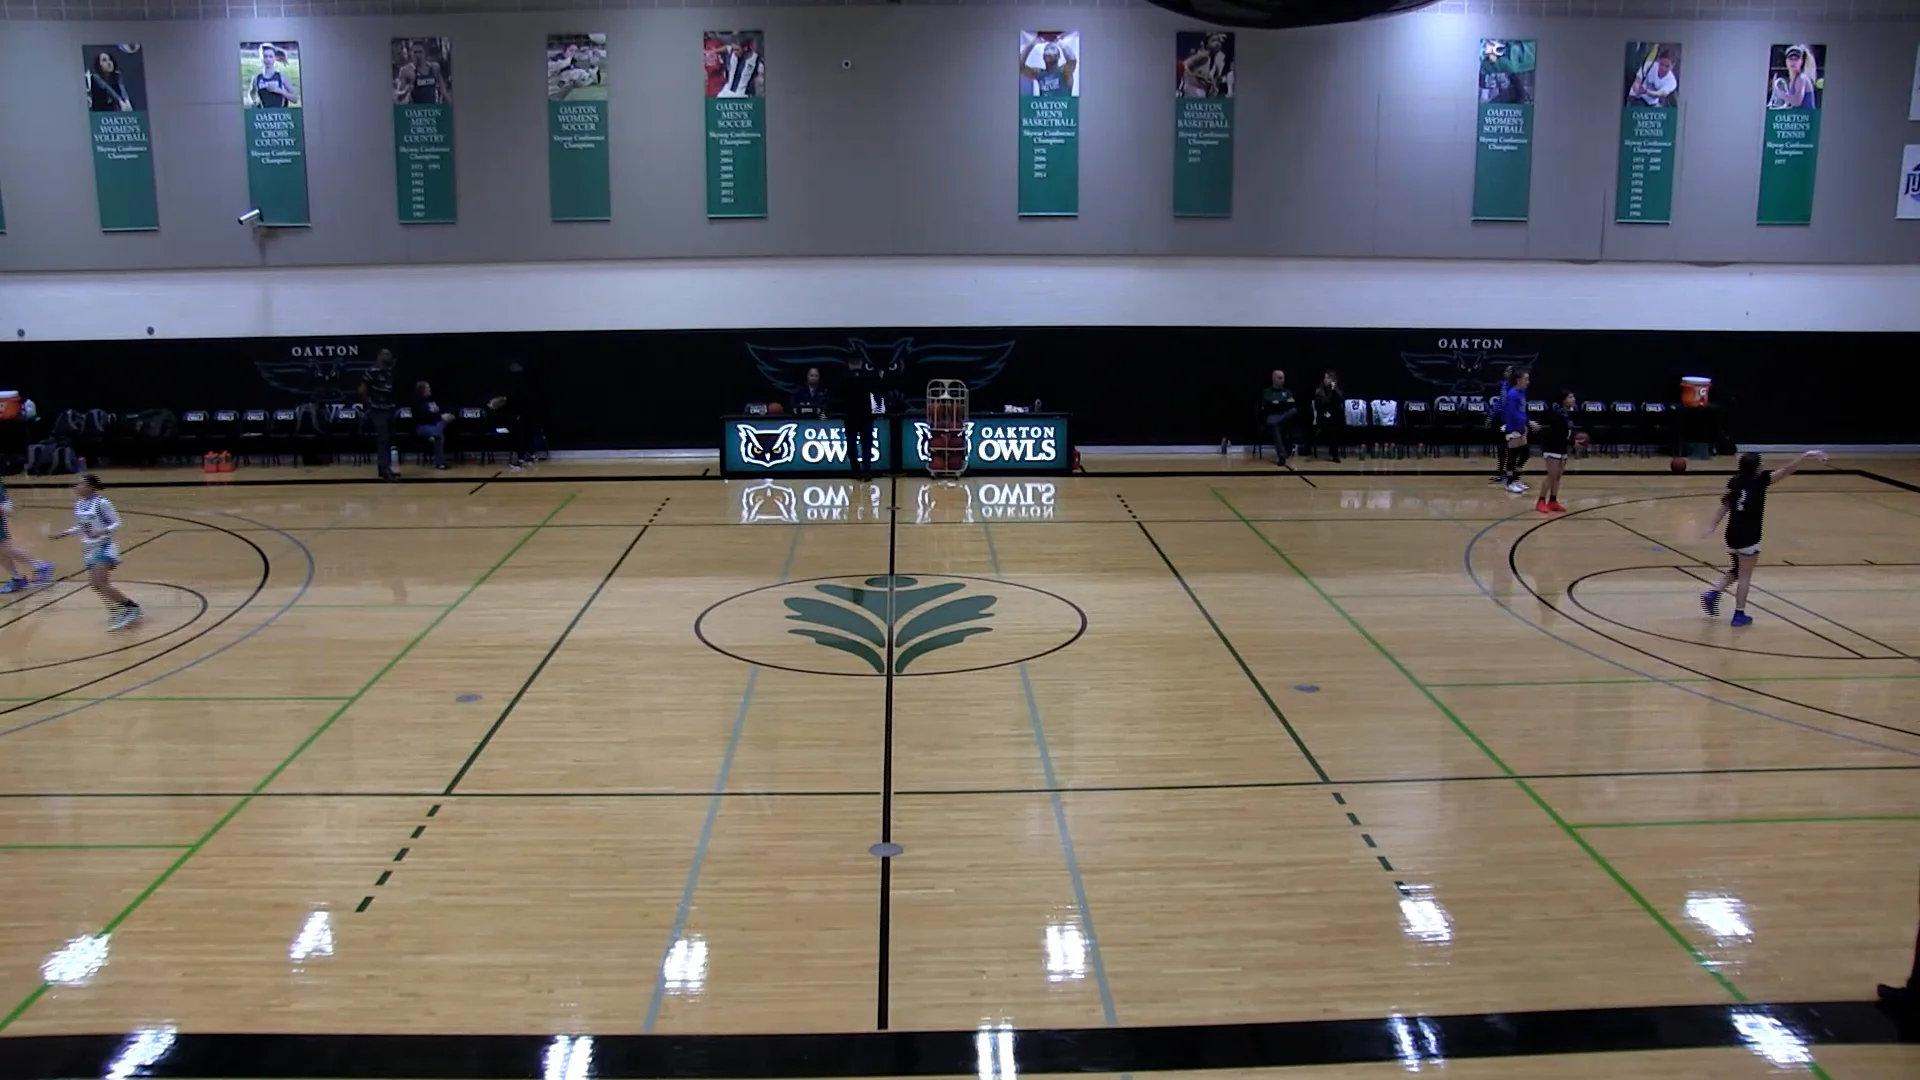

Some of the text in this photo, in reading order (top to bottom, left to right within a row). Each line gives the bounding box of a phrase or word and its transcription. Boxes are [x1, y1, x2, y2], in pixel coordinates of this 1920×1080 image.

[716, 103, 753, 111] OAKTON
[1031, 101, 1068, 109] OAKTON
[1186, 103, 1222, 111] OAKTON
[405, 109, 441, 117] OAKTON
[560, 106, 596, 114] OAKTON
[1037, 110, 1062, 118] MEN'S
[1487, 108, 1522, 117] OAKTON
[255, 112, 292, 121] OAKTON
[558, 114, 599, 123] WOMEN'S
[721, 111, 748, 119] MEN'S
[1184, 111, 1224, 119] WOMEN'S
[1633, 112, 1666, 120] OAKTON
[1775, 114, 1809, 122] OAKTON
[101, 116, 137, 125] OAKTON
[718, 120, 752, 128] SOCCER
[1023, 118, 1076, 126] BASKETBALL
[1178, 120, 1231, 128] BASKETBALL
[1485, 117, 1524, 125] WOMEN'S
[100, 125, 140, 133] WOMEN'S
[254, 121, 294, 129] WOMEN'S
[561, 123, 596, 131] SOCCER
[1483, 125, 1524, 133] SOFTBALL
[261, 130, 289, 138] CROSS
[411, 126, 437, 134] CROSS
[94, 133, 148, 142] VOLLEYBALL
[404, 135, 445, 143] COUNTRY
[255, 138, 296, 147] COUNTRY
[1438, 338, 1504, 349] OAKTON
[292, 345, 359, 357] OAKTON
[981, 427, 1055, 438] OAKTON
[979, 439, 1056, 461] OWLS
